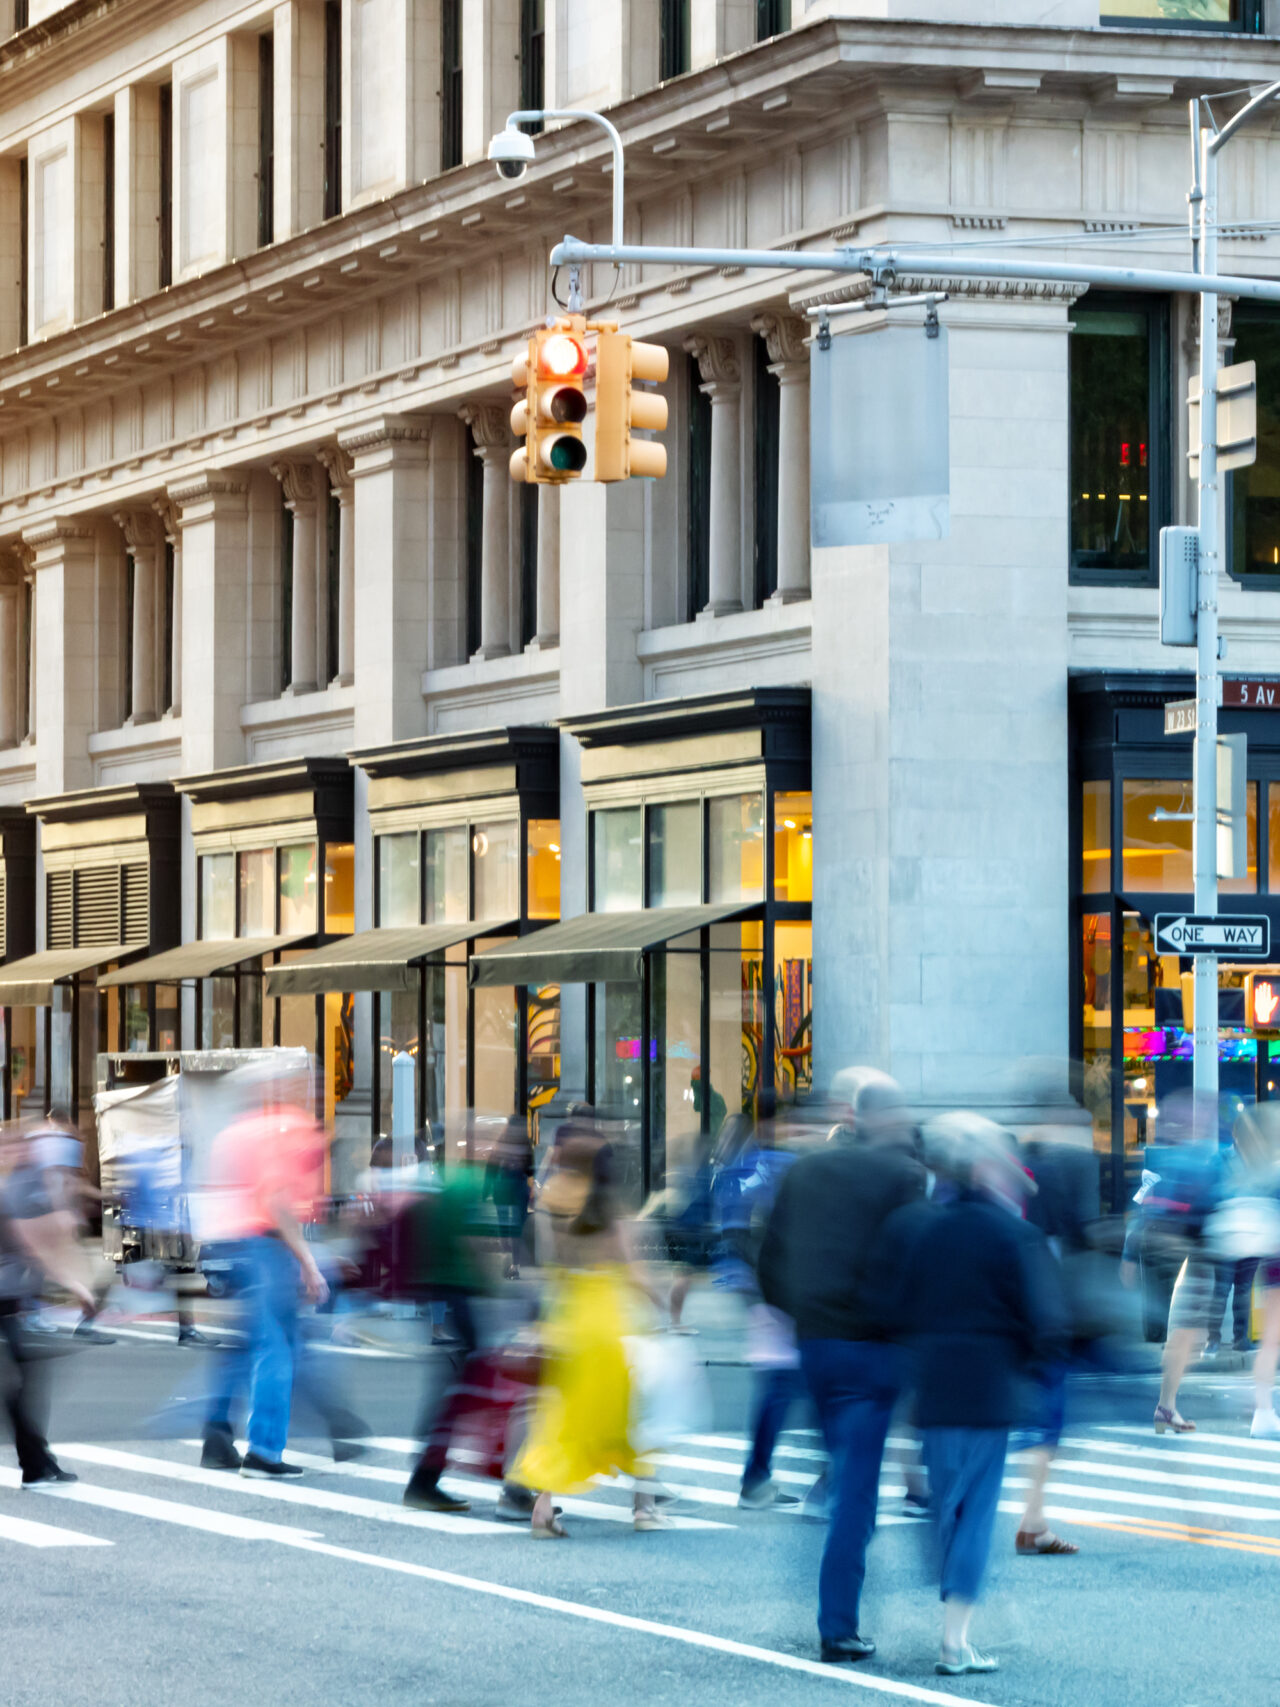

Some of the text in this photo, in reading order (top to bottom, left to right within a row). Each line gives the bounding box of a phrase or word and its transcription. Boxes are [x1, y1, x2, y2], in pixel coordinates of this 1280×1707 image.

[1241, 685, 1275, 705] 5 Av
[1167, 708, 1195, 731] W 23 St
[1171, 927, 1259, 943] ONE WAY
